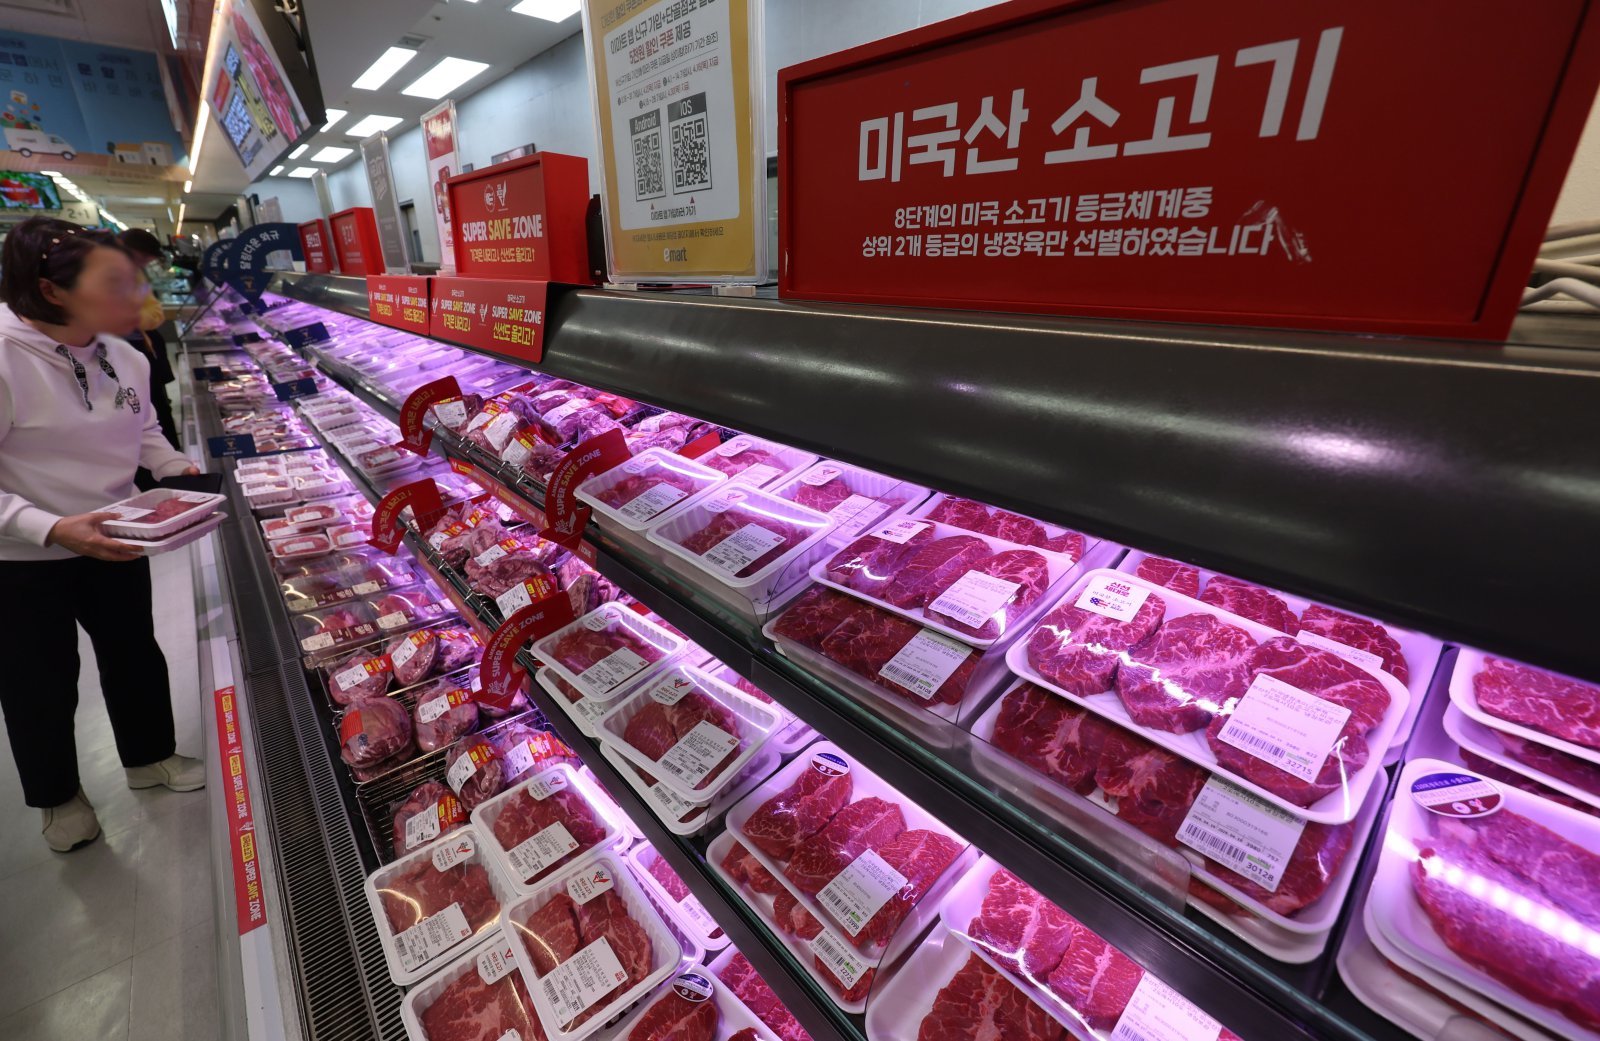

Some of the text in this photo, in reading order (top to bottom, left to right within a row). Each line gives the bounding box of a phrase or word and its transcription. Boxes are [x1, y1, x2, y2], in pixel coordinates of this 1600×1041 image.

[634, 20, 648, 40] 신규
[645, 37, 659, 57] 할인
[660, 29, 674, 48] 쿠폰
[675, 20, 691, 42] 제공
[859, 26, 1343, 182] 미국산 소고기
[634, 113, 657, 133] Android
[895, 186, 1213, 229] 8단계의 미국 소고기 등급체계중
[462, 214, 543, 242] SUPER SAVE ZONE
[862, 224, 1273, 257] 상위 2개 등급의 냉장육만 선별하였습니다
[516, 247, 532, 262] 올리고
[664, 247, 688, 262] emart
[441, 299, 476, 314] SUPER SAVE ZONE
[492, 306, 542, 324] SUPER SAVE ZONE
[493, 322, 531, 346] 신선도 올리고
[577, 449, 602, 466] ZONE
[561, 464, 579, 487] SAVE
[557, 488, 566, 516] SUPER
[488, 623, 514, 660] AMERICAN BEEF
[492, 611, 545, 678] SUPER SAVE ZONE
[1285, 760, 1312, 775] 32715
[238, 803, 248, 820] ZONE
[1246, 862, 1274, 881] 30128
[245, 860, 261, 921] SUPER SAVE ZONE
[846, 918, 859, 930] 23999
